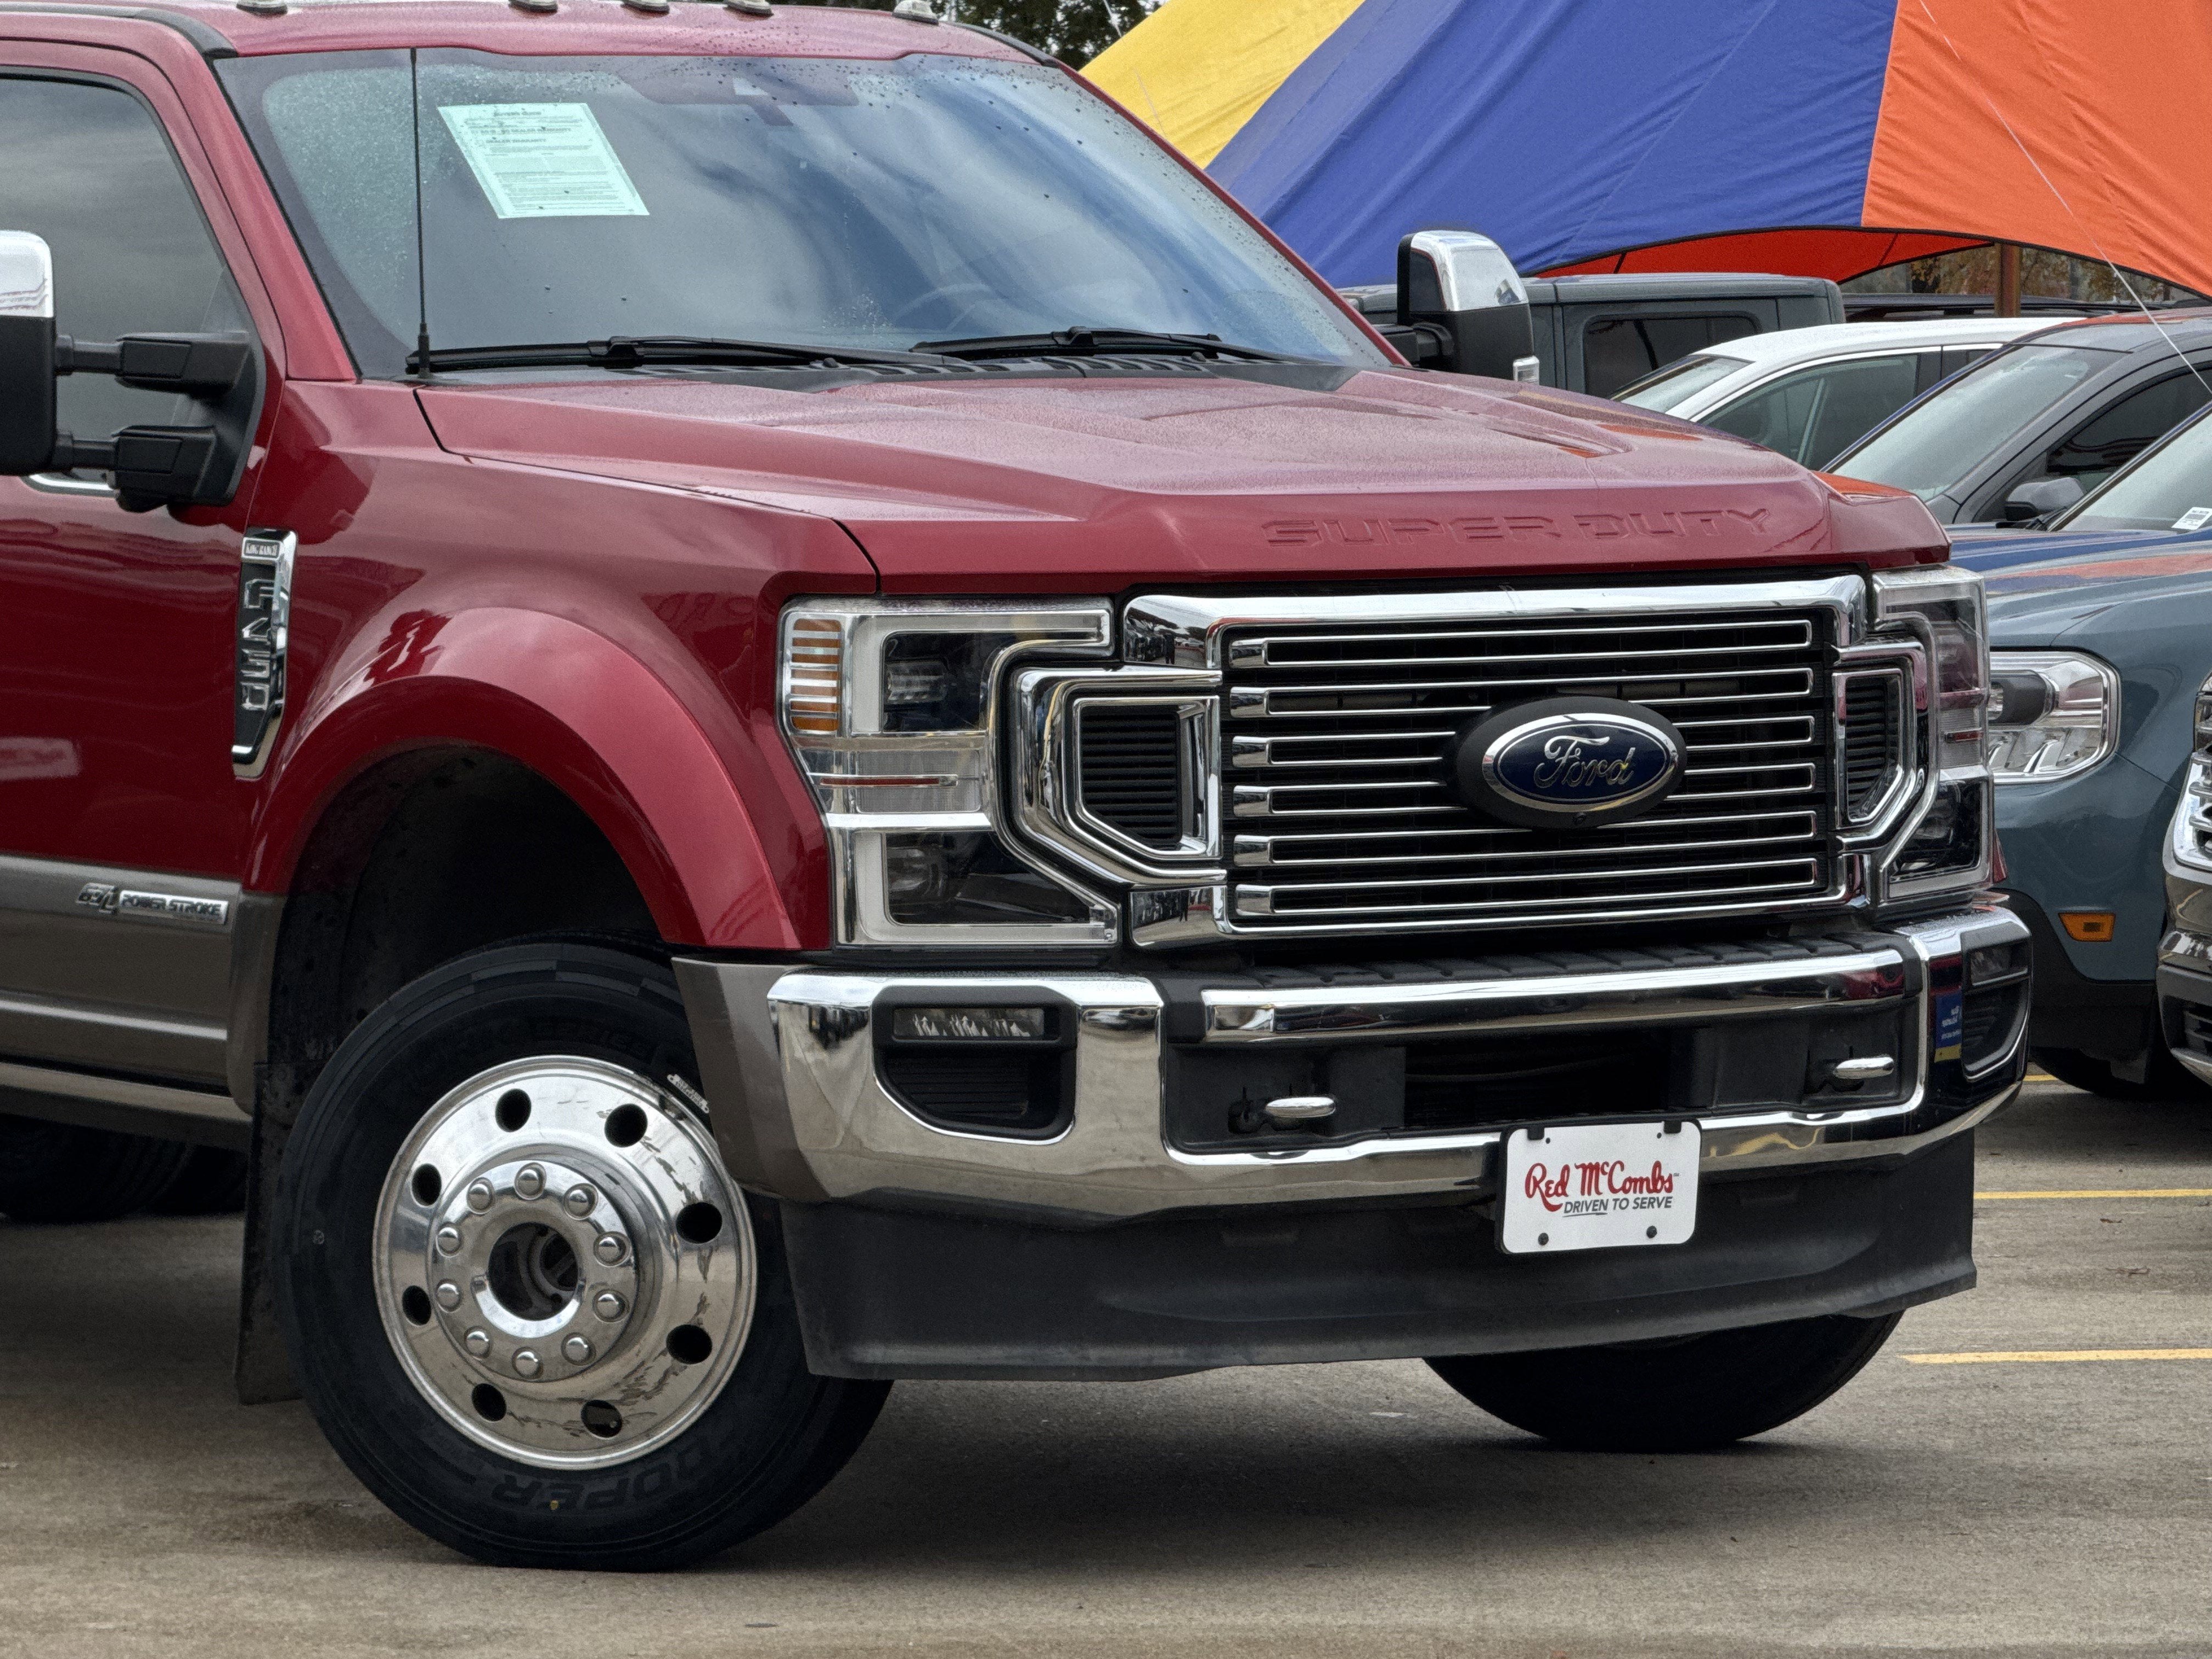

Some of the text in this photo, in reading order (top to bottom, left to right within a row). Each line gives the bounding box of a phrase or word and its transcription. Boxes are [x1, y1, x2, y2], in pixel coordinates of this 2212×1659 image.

[1261, 508, 1770, 546] SUPER DUTY
[1534, 736, 1636, 788] Ford
[168, 899, 222, 916] STROKE
[1525, 1160, 1674, 1212] Red McCombs
[1563, 1196, 1674, 1214] DRIVEN TO SERVE
[492, 1429, 727, 1511] OOPER
